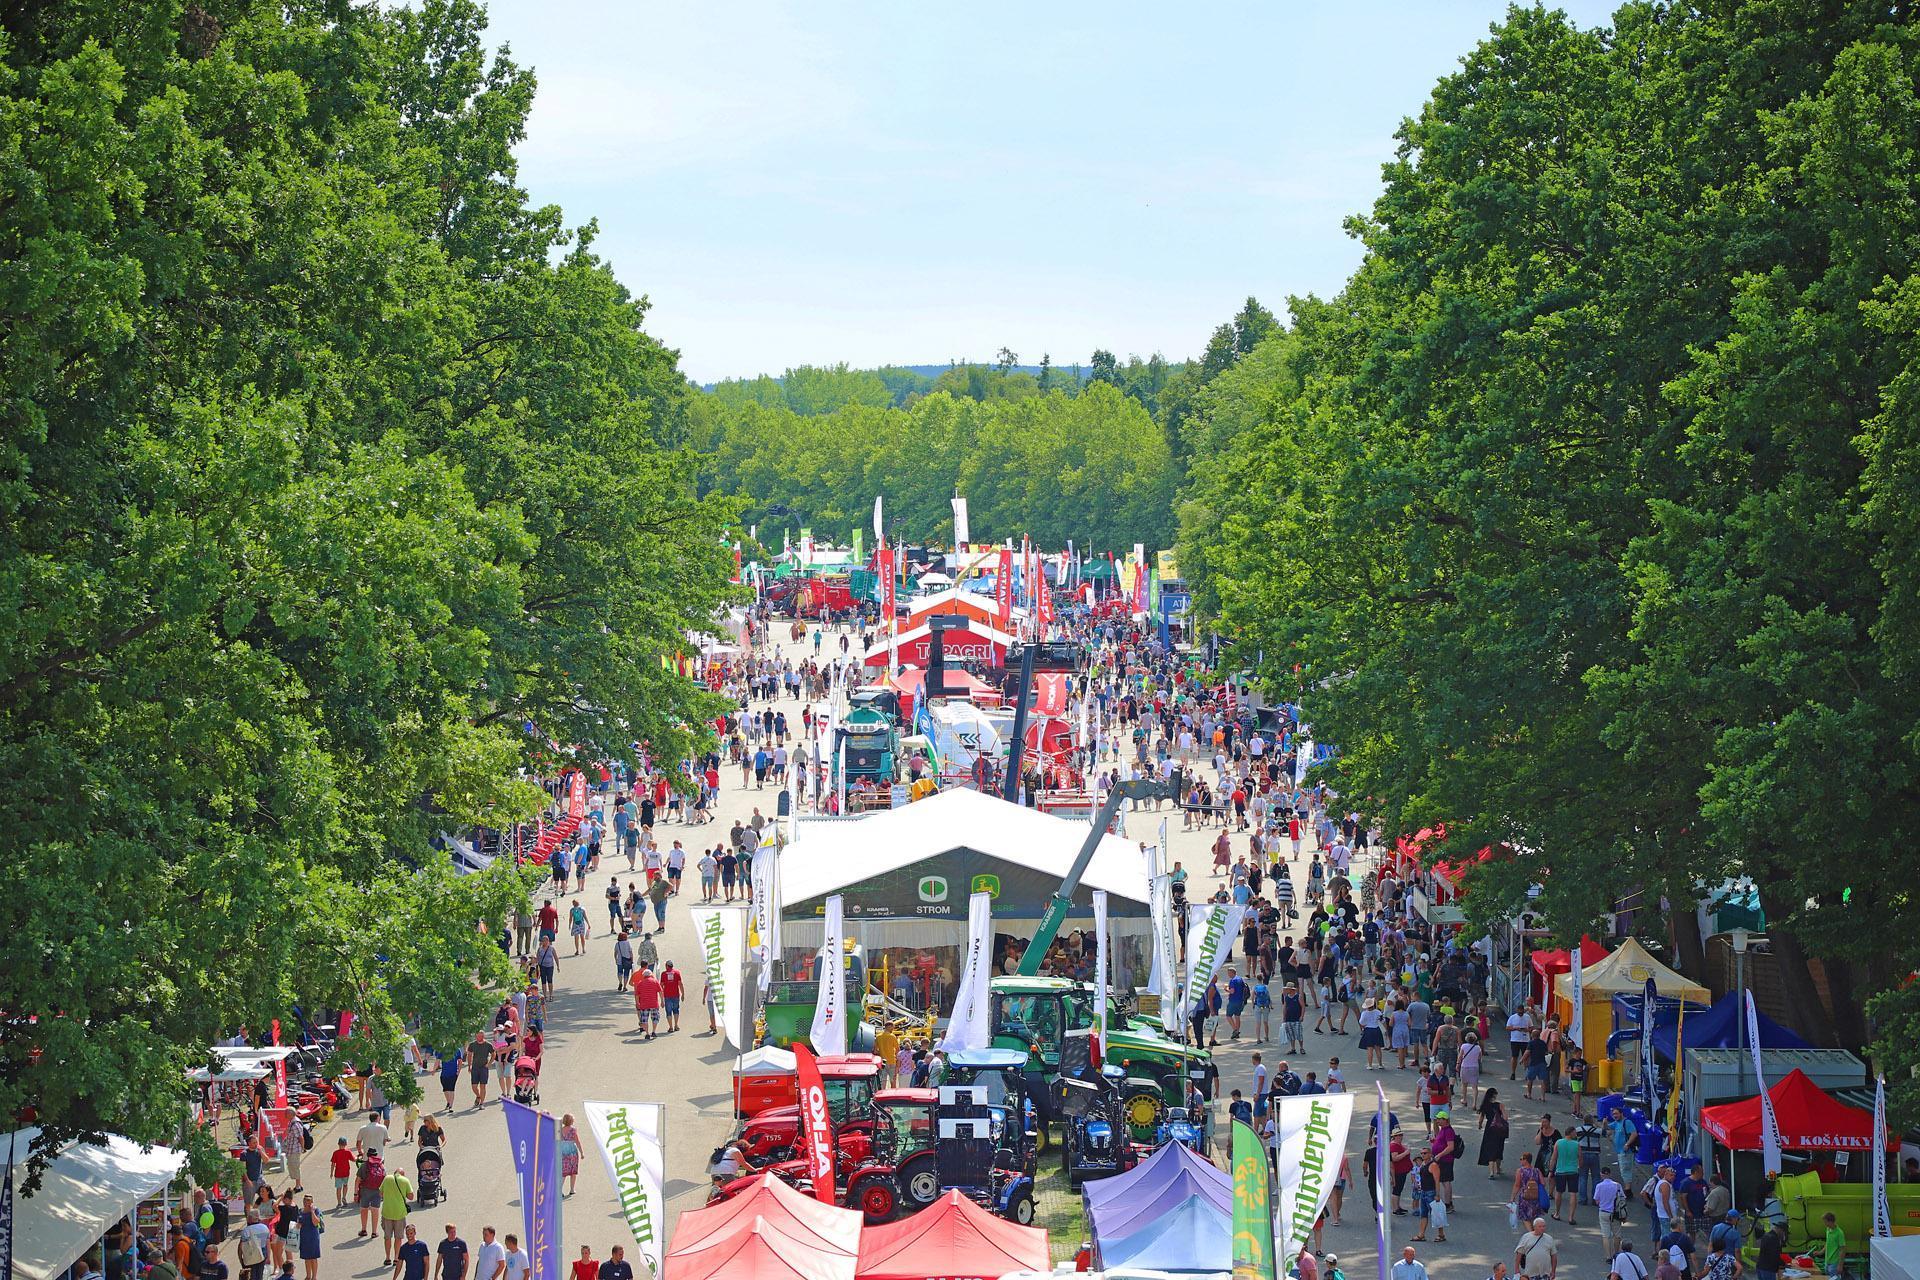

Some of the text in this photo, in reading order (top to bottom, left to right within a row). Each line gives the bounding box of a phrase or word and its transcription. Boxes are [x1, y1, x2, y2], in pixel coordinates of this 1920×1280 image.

[916, 643, 991, 659] TPAGRI
[574, 772, 585, 802] SECO
[916, 906, 950, 914] STROM
[1800, 1133, 1872, 1147] KOŠÁTKY
